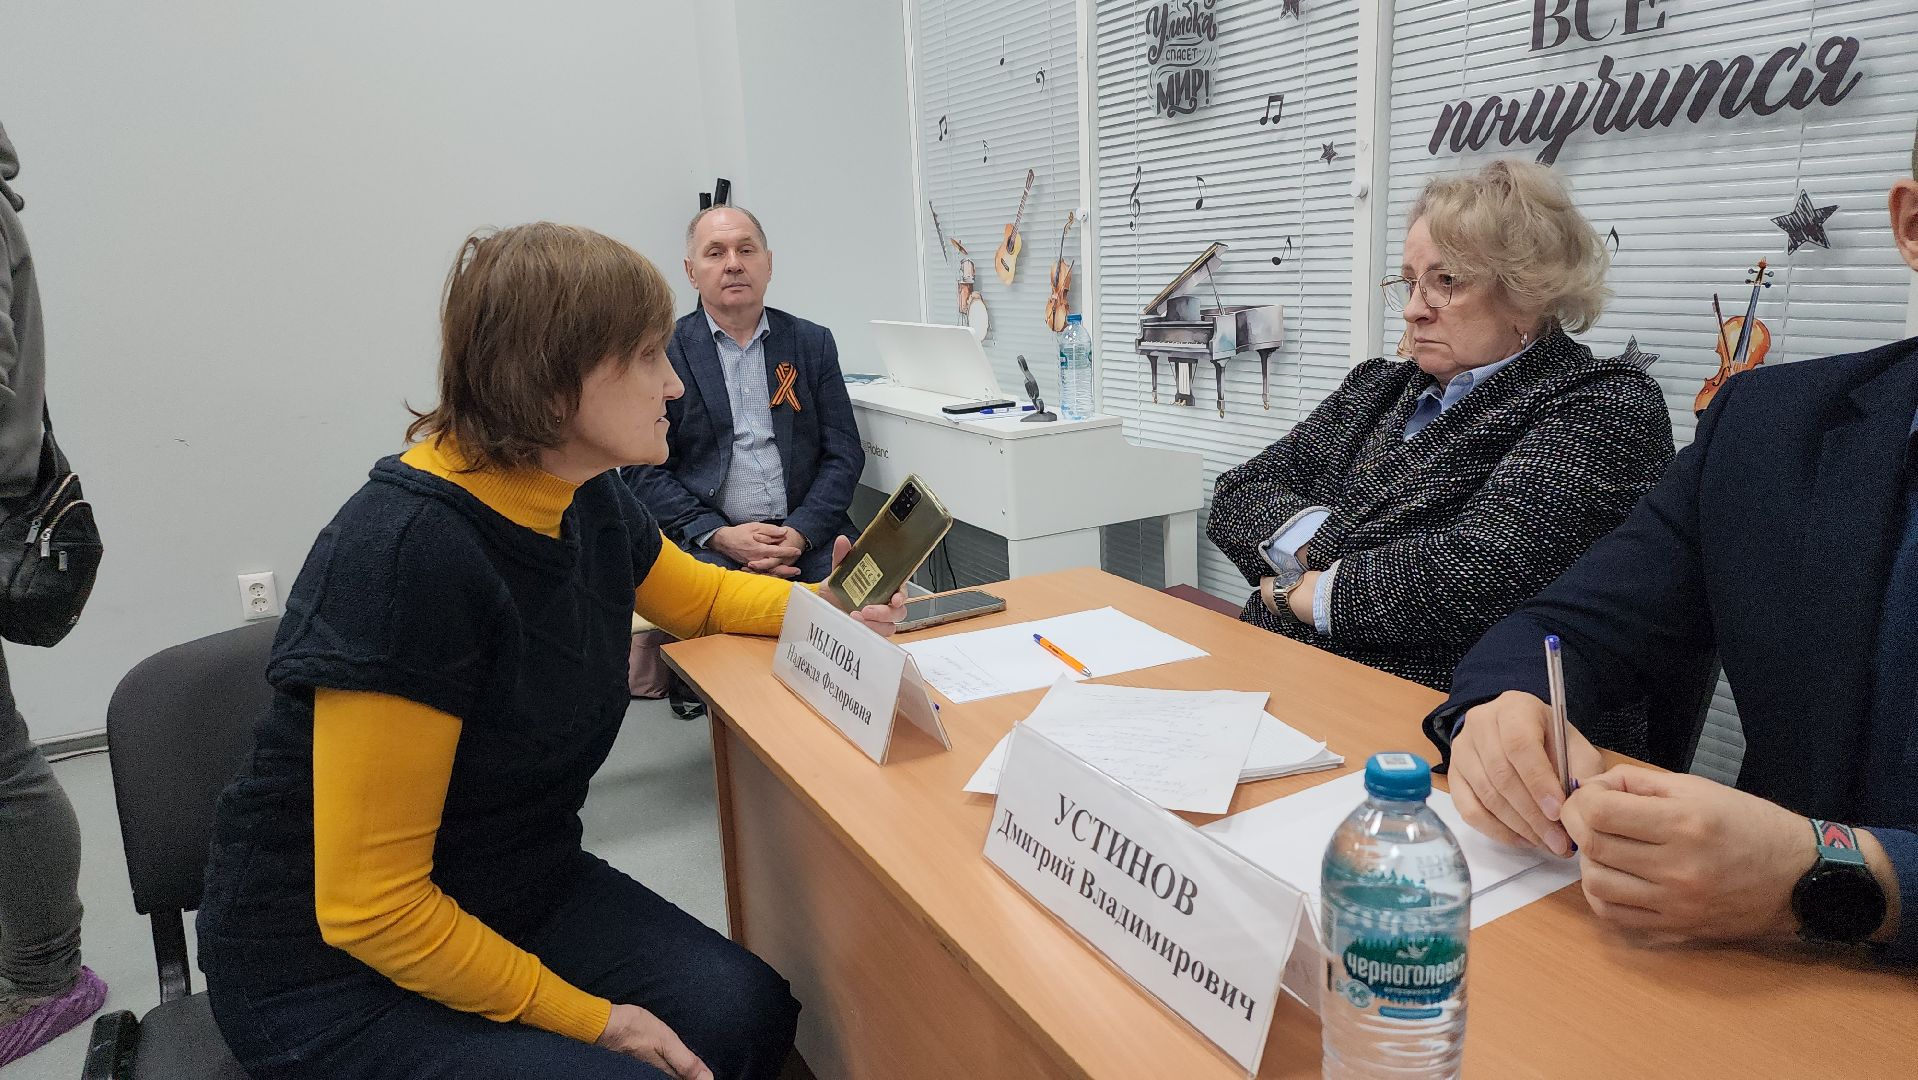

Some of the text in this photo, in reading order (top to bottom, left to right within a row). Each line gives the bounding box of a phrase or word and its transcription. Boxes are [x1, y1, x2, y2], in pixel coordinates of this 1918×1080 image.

[1156, 69, 1209, 118] МИР!
[1165, 47, 1198, 61] СПАСЕТ
[1428, 35, 1863, 168] получится
[786, 643, 821, 683] Надежда
[822, 672, 872, 725] Федоровна
[806, 621, 861, 680] МЫЛОВА
[1054, 792, 1199, 916] УСТИНОВ
[996, 808, 1256, 1022] Дмитрий Владимирович
